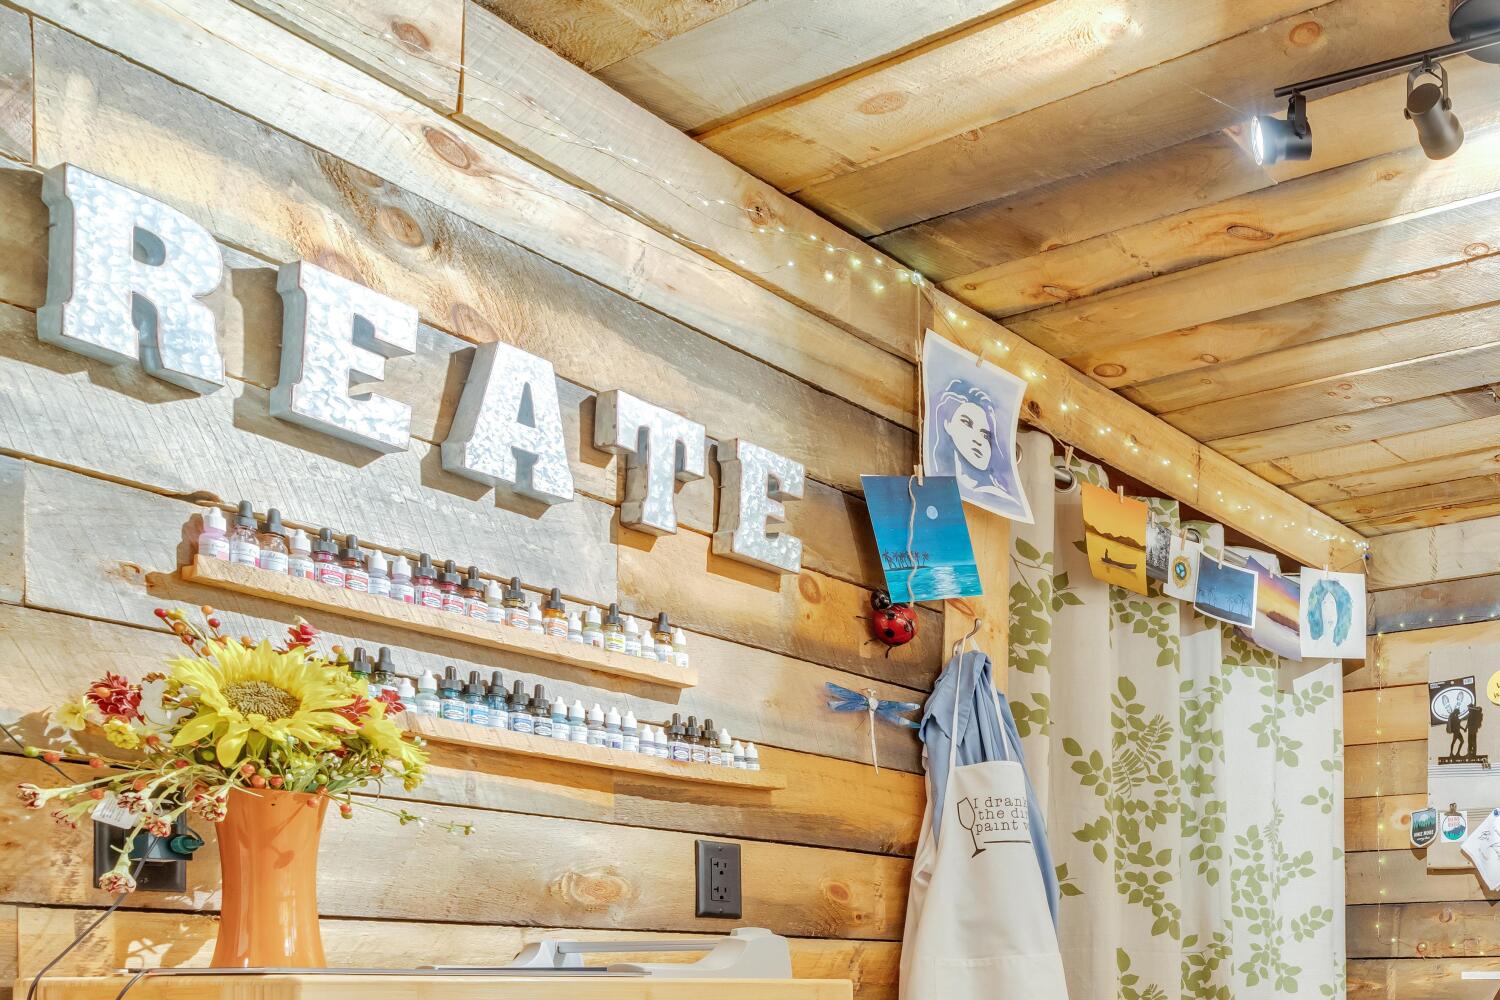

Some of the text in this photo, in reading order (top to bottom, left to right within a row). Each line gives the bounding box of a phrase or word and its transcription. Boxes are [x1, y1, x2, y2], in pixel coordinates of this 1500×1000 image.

[37, 163, 806, 576] REATE
[973, 797, 979, 809] I
[978, 808, 1005, 821] the
[974, 819, 1019, 835] paint
